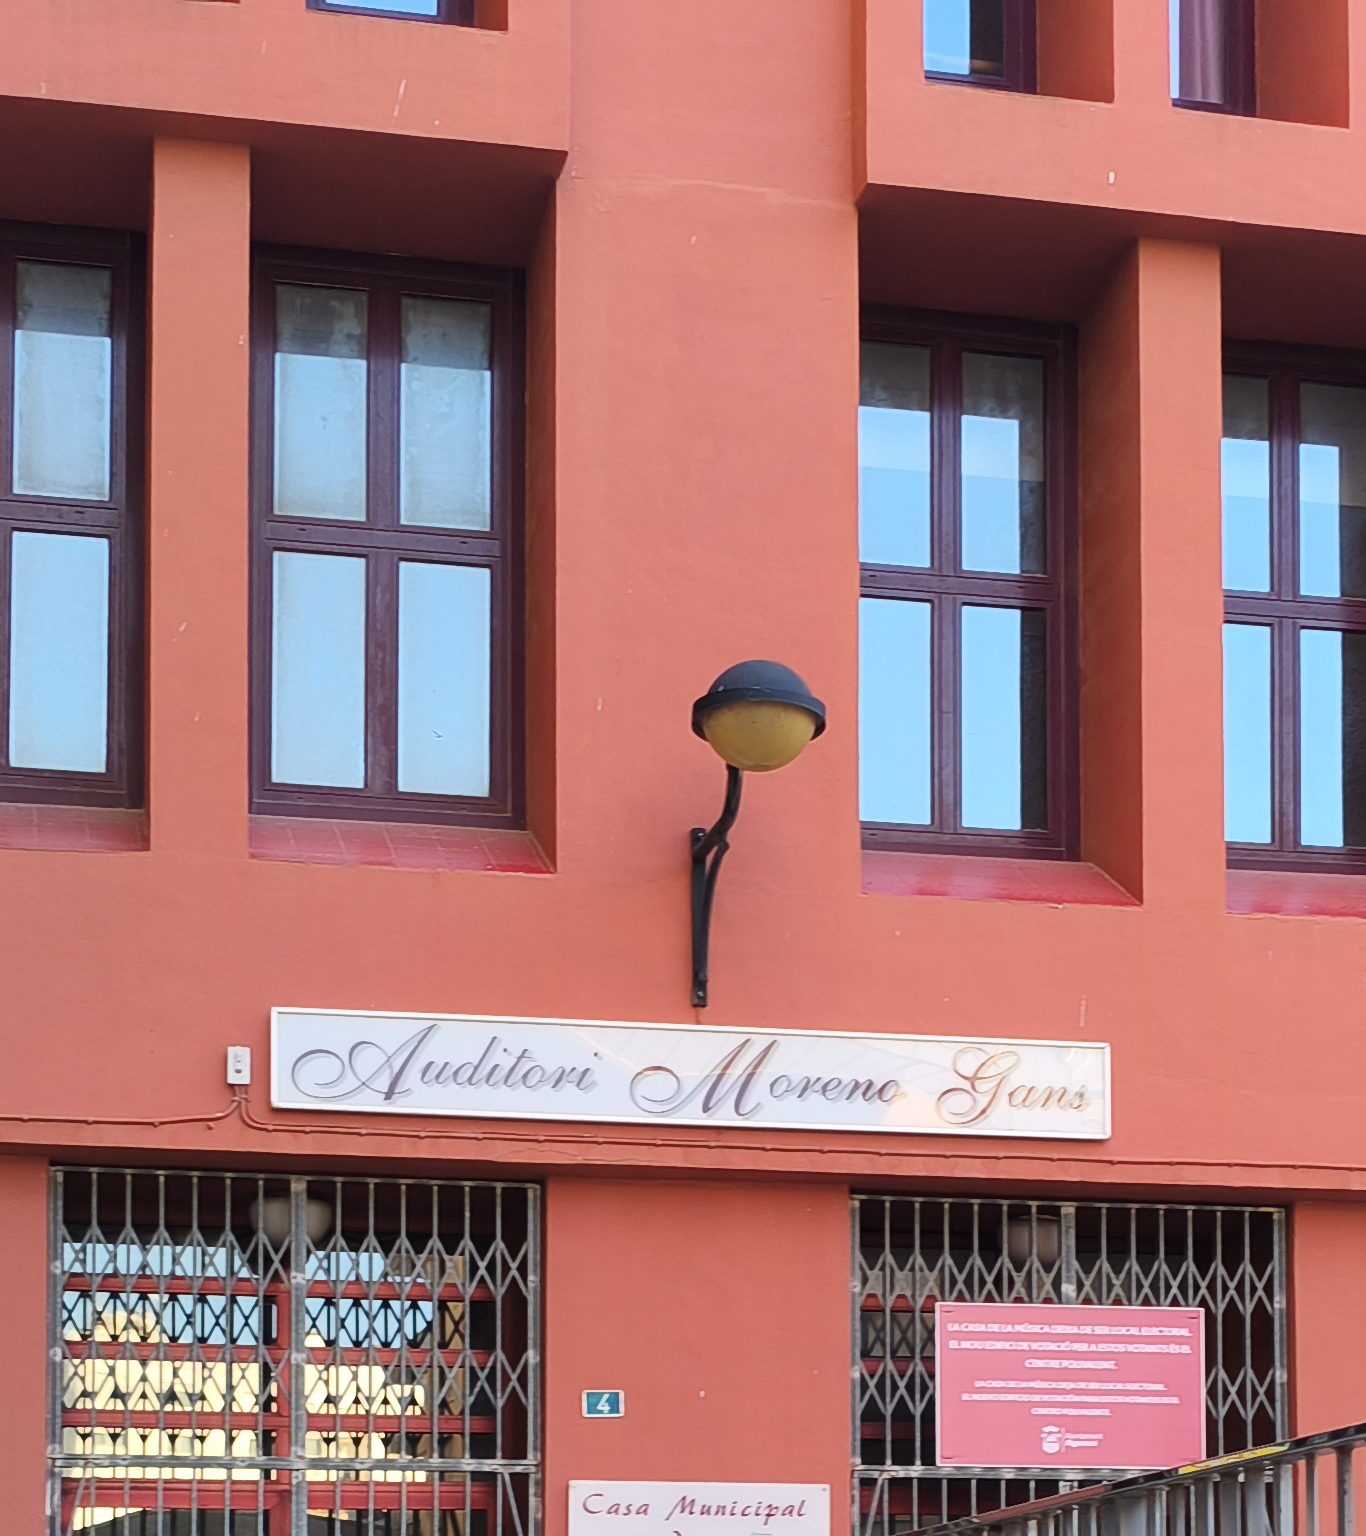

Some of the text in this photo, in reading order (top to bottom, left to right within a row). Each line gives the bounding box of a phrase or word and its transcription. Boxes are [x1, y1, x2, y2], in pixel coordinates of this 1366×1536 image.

[291, 1023, 1089, 1125] Auditori Moreno Gans
[596, 1393, 611, 1414] 4
[582, 1493, 807, 1526] Casa Municipal
